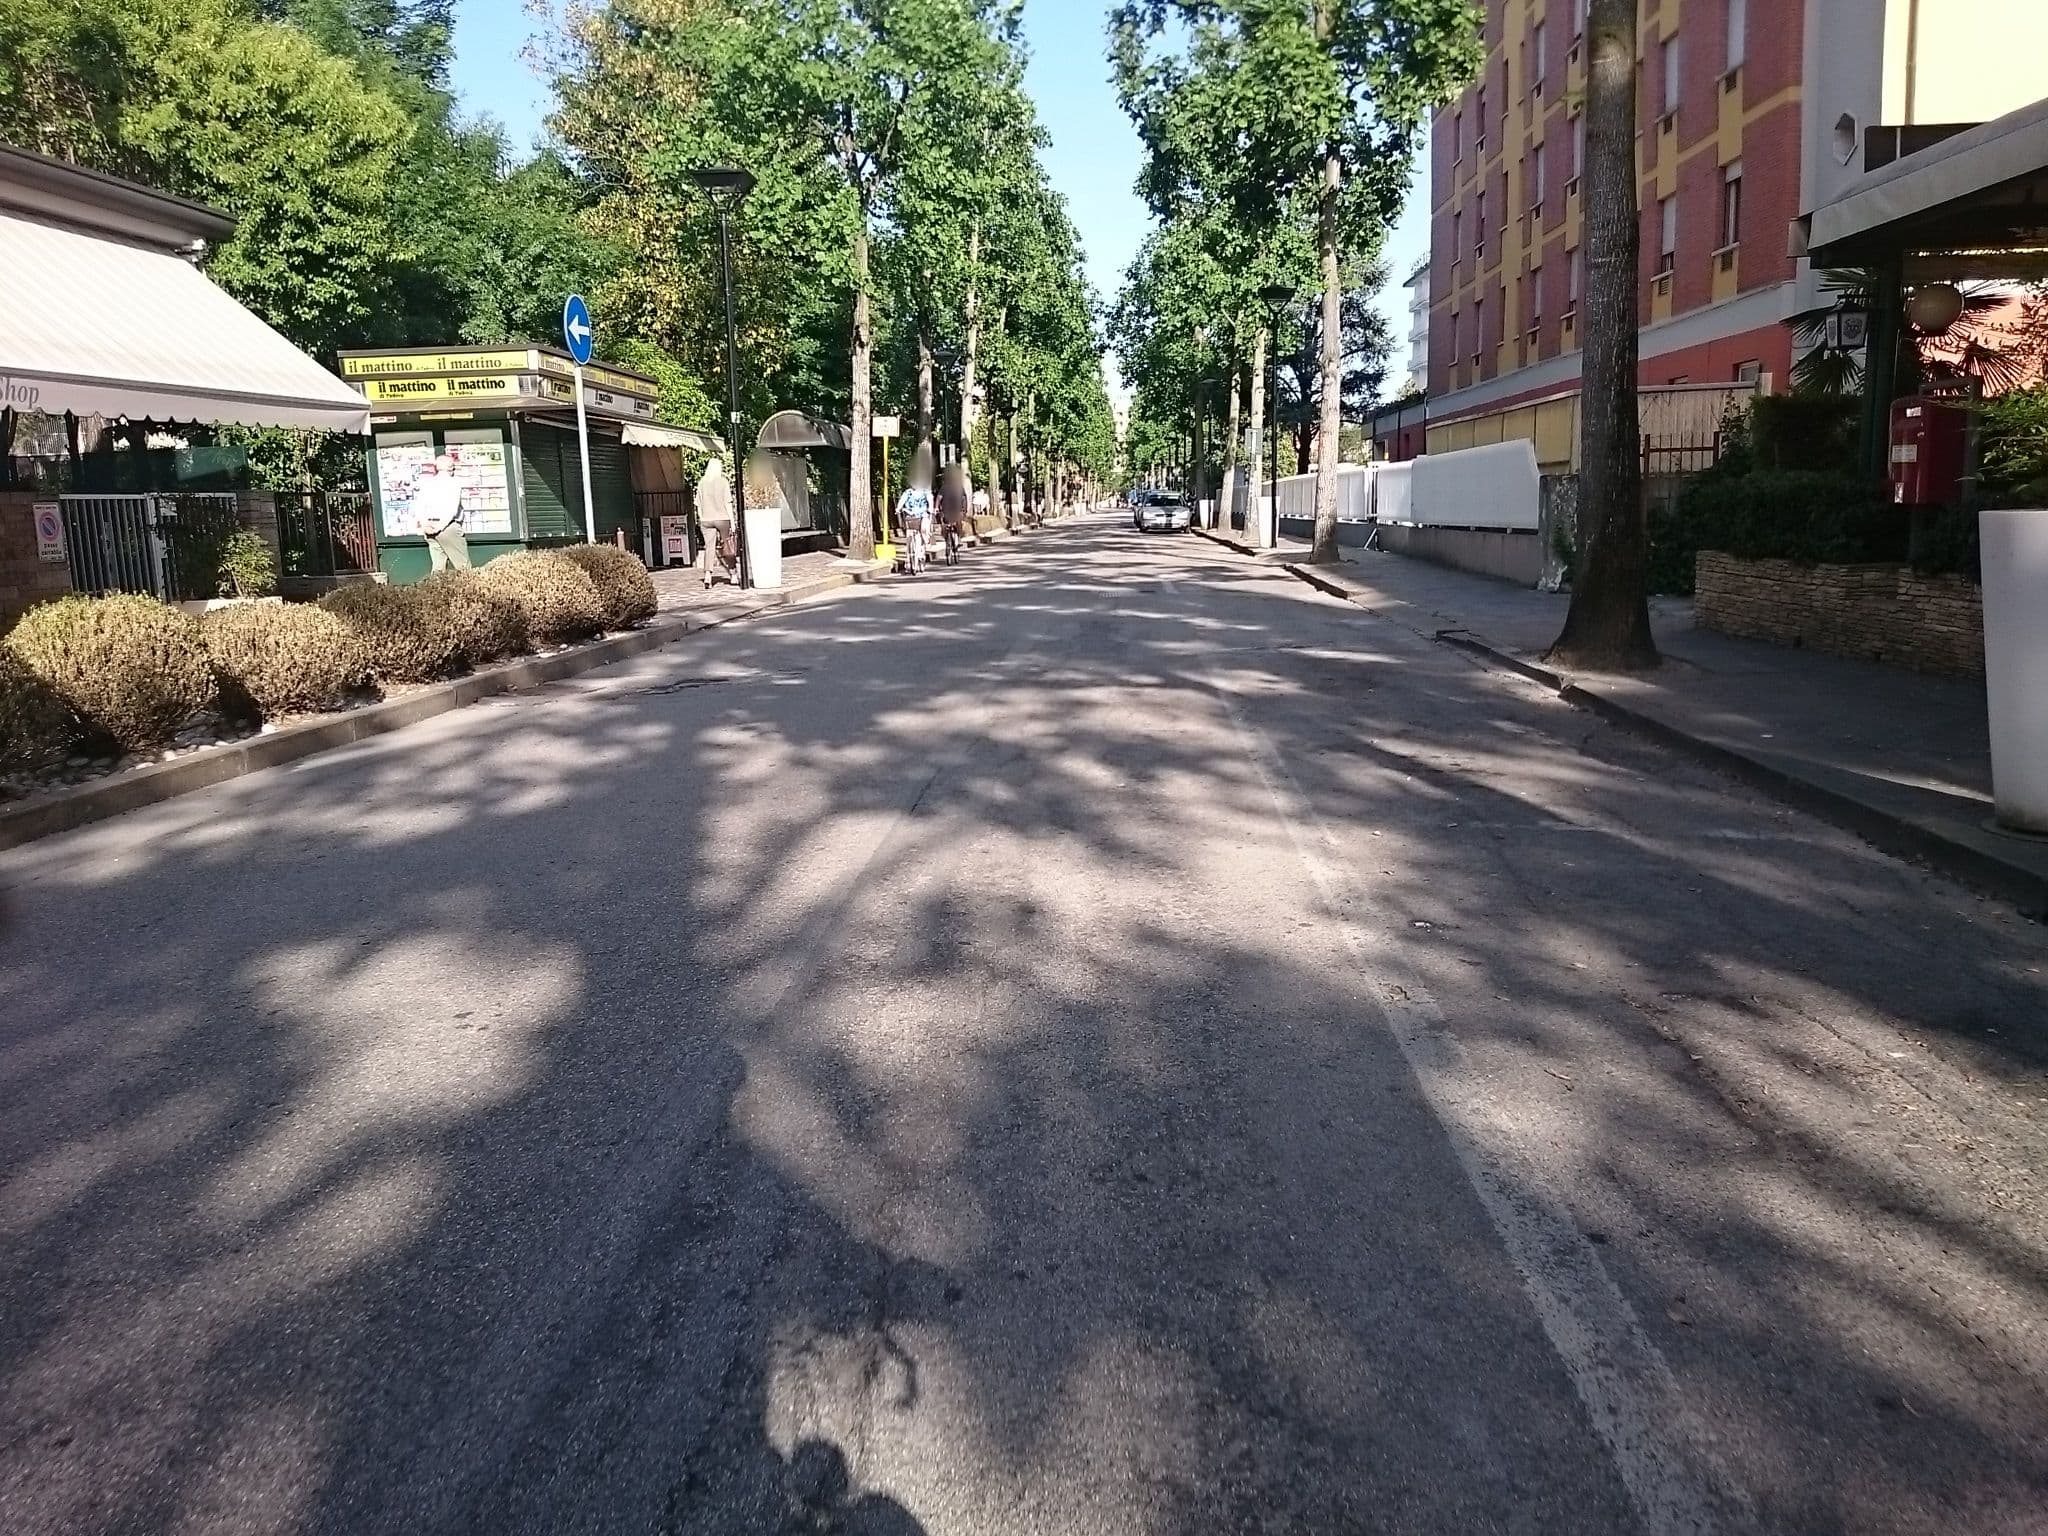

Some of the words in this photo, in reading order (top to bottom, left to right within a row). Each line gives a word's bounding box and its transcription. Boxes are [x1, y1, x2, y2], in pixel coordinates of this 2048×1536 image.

[348, 360, 358, 373] il
[361, 360, 413, 373] mattino
[437, 357, 446, 370] il
[450, 356, 502, 369] mattino
[378, 381, 386, 393] il
[389, 380, 436, 393] mattino
[447, 379, 455, 390] il
[458, 377, 506, 390] mattino
